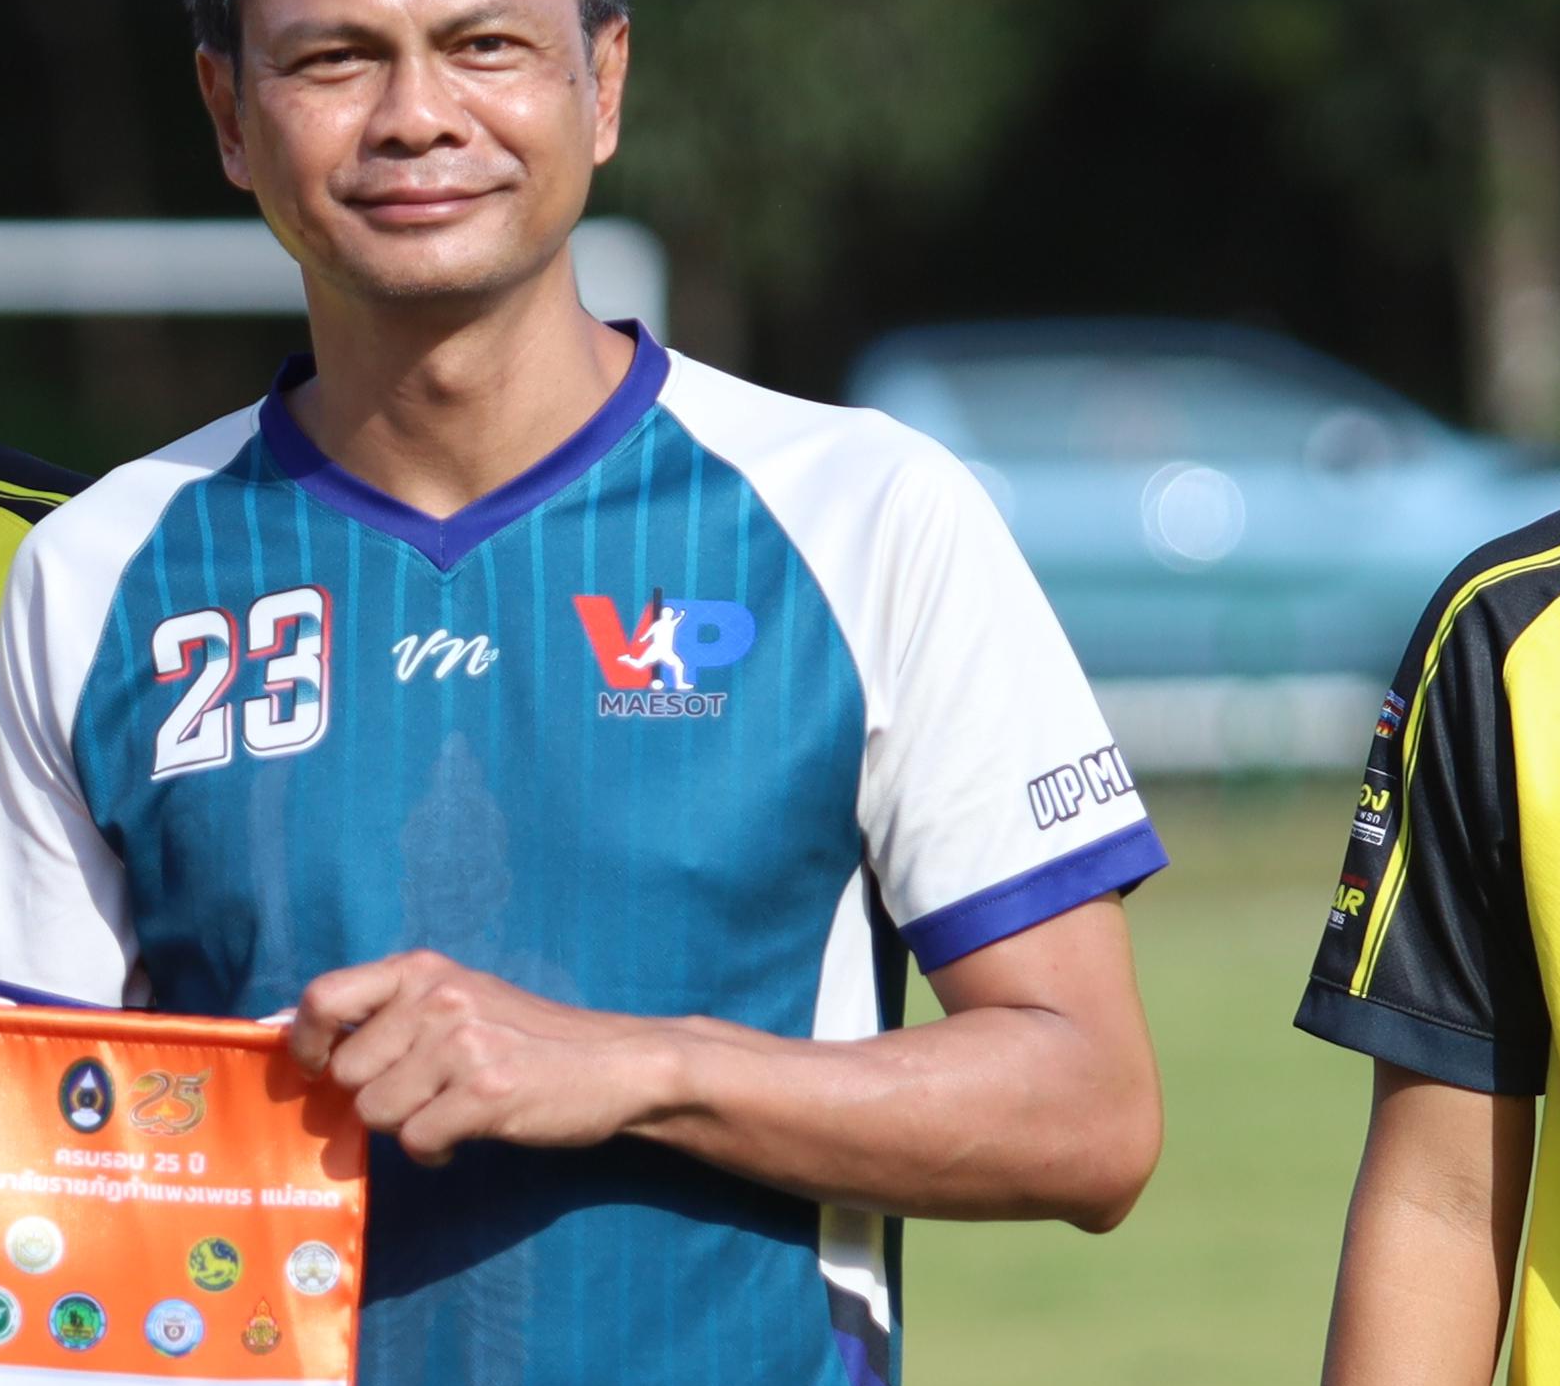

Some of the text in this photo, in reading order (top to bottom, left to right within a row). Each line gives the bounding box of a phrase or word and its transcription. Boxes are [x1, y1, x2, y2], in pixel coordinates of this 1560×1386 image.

[151, 583, 332, 781] 23
[598, 691, 727, 718] MAESOT
[54, 1145, 206, 1176] ครบรอบ 25 ปี
[261, 1181, 340, 1209] แม่สอด
